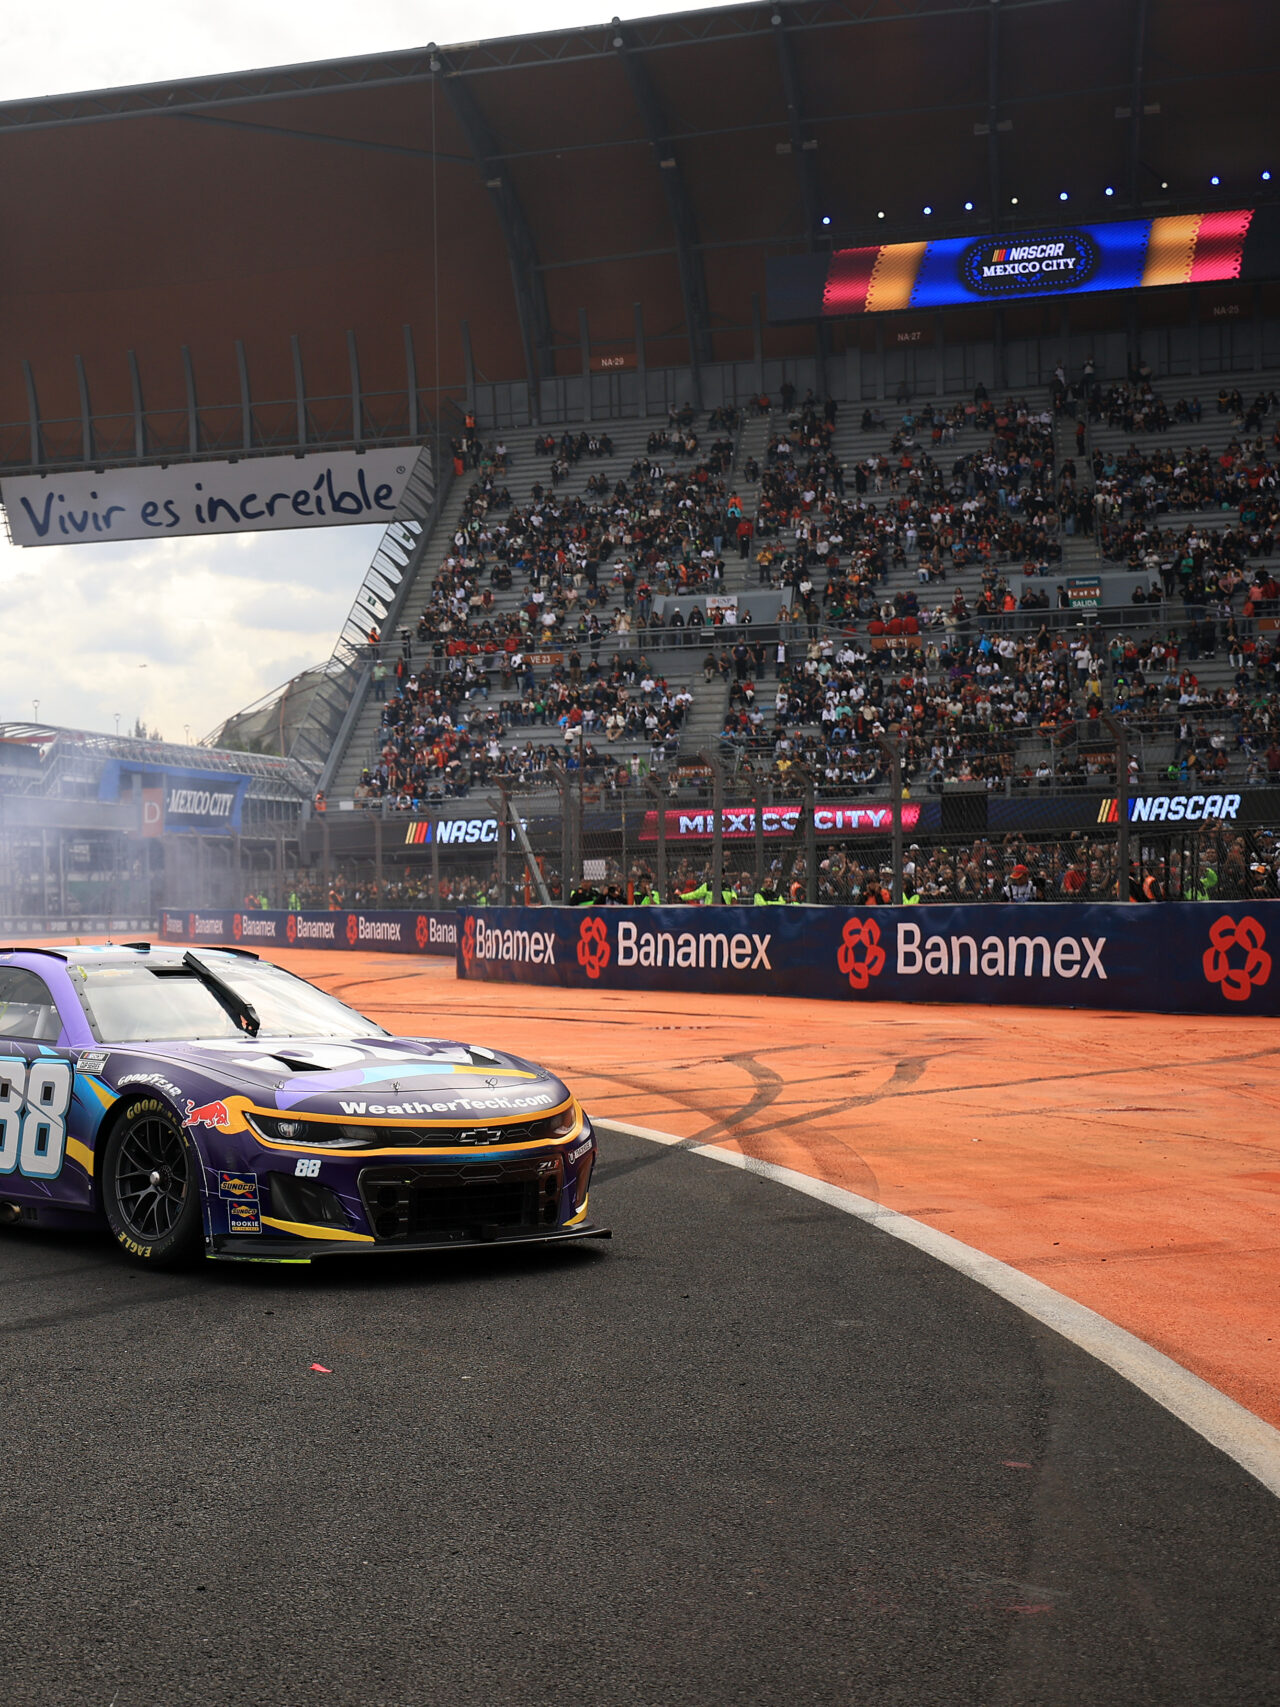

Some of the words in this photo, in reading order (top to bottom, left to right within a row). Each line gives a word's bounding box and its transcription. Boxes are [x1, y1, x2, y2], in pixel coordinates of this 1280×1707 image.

[1009, 243, 1064, 260] NASCAR
[982, 262, 1040, 277] MEXICO
[1042, 258, 1076, 271] CITY
[21, 491, 126, 538] Vivir
[140, 500, 182, 528] es
[195, 468, 397, 524] increíble
[1072, 599, 1098, 608] SALIDA
[885, 638, 897, 648] VE
[530, 655, 541, 664] VE
[144, 801, 161, 823] D
[168, 789, 210, 815] MEXICO
[209, 792, 234, 816] CITY
[1131, 794, 1241, 822] NASCAR
[814, 809, 887, 830] CITY
[195, 914, 223, 934] Banamex
[242, 915, 276, 937] Banamex
[297, 916, 335, 939] Banamex
[358, 916, 401, 941] Banamex
[429, 918, 457, 943] Bana
[476, 919, 556, 965] Banamex
[617, 921, 772, 970] Banamex
[896, 922, 1107, 980] Banamex
[117, 1073, 182, 1097] GOODYEAR
[294, 1159, 322, 1178] 88
[221, 1182, 256, 1191] SUNOCO
[117, 1231, 152, 1257] EAGLE
